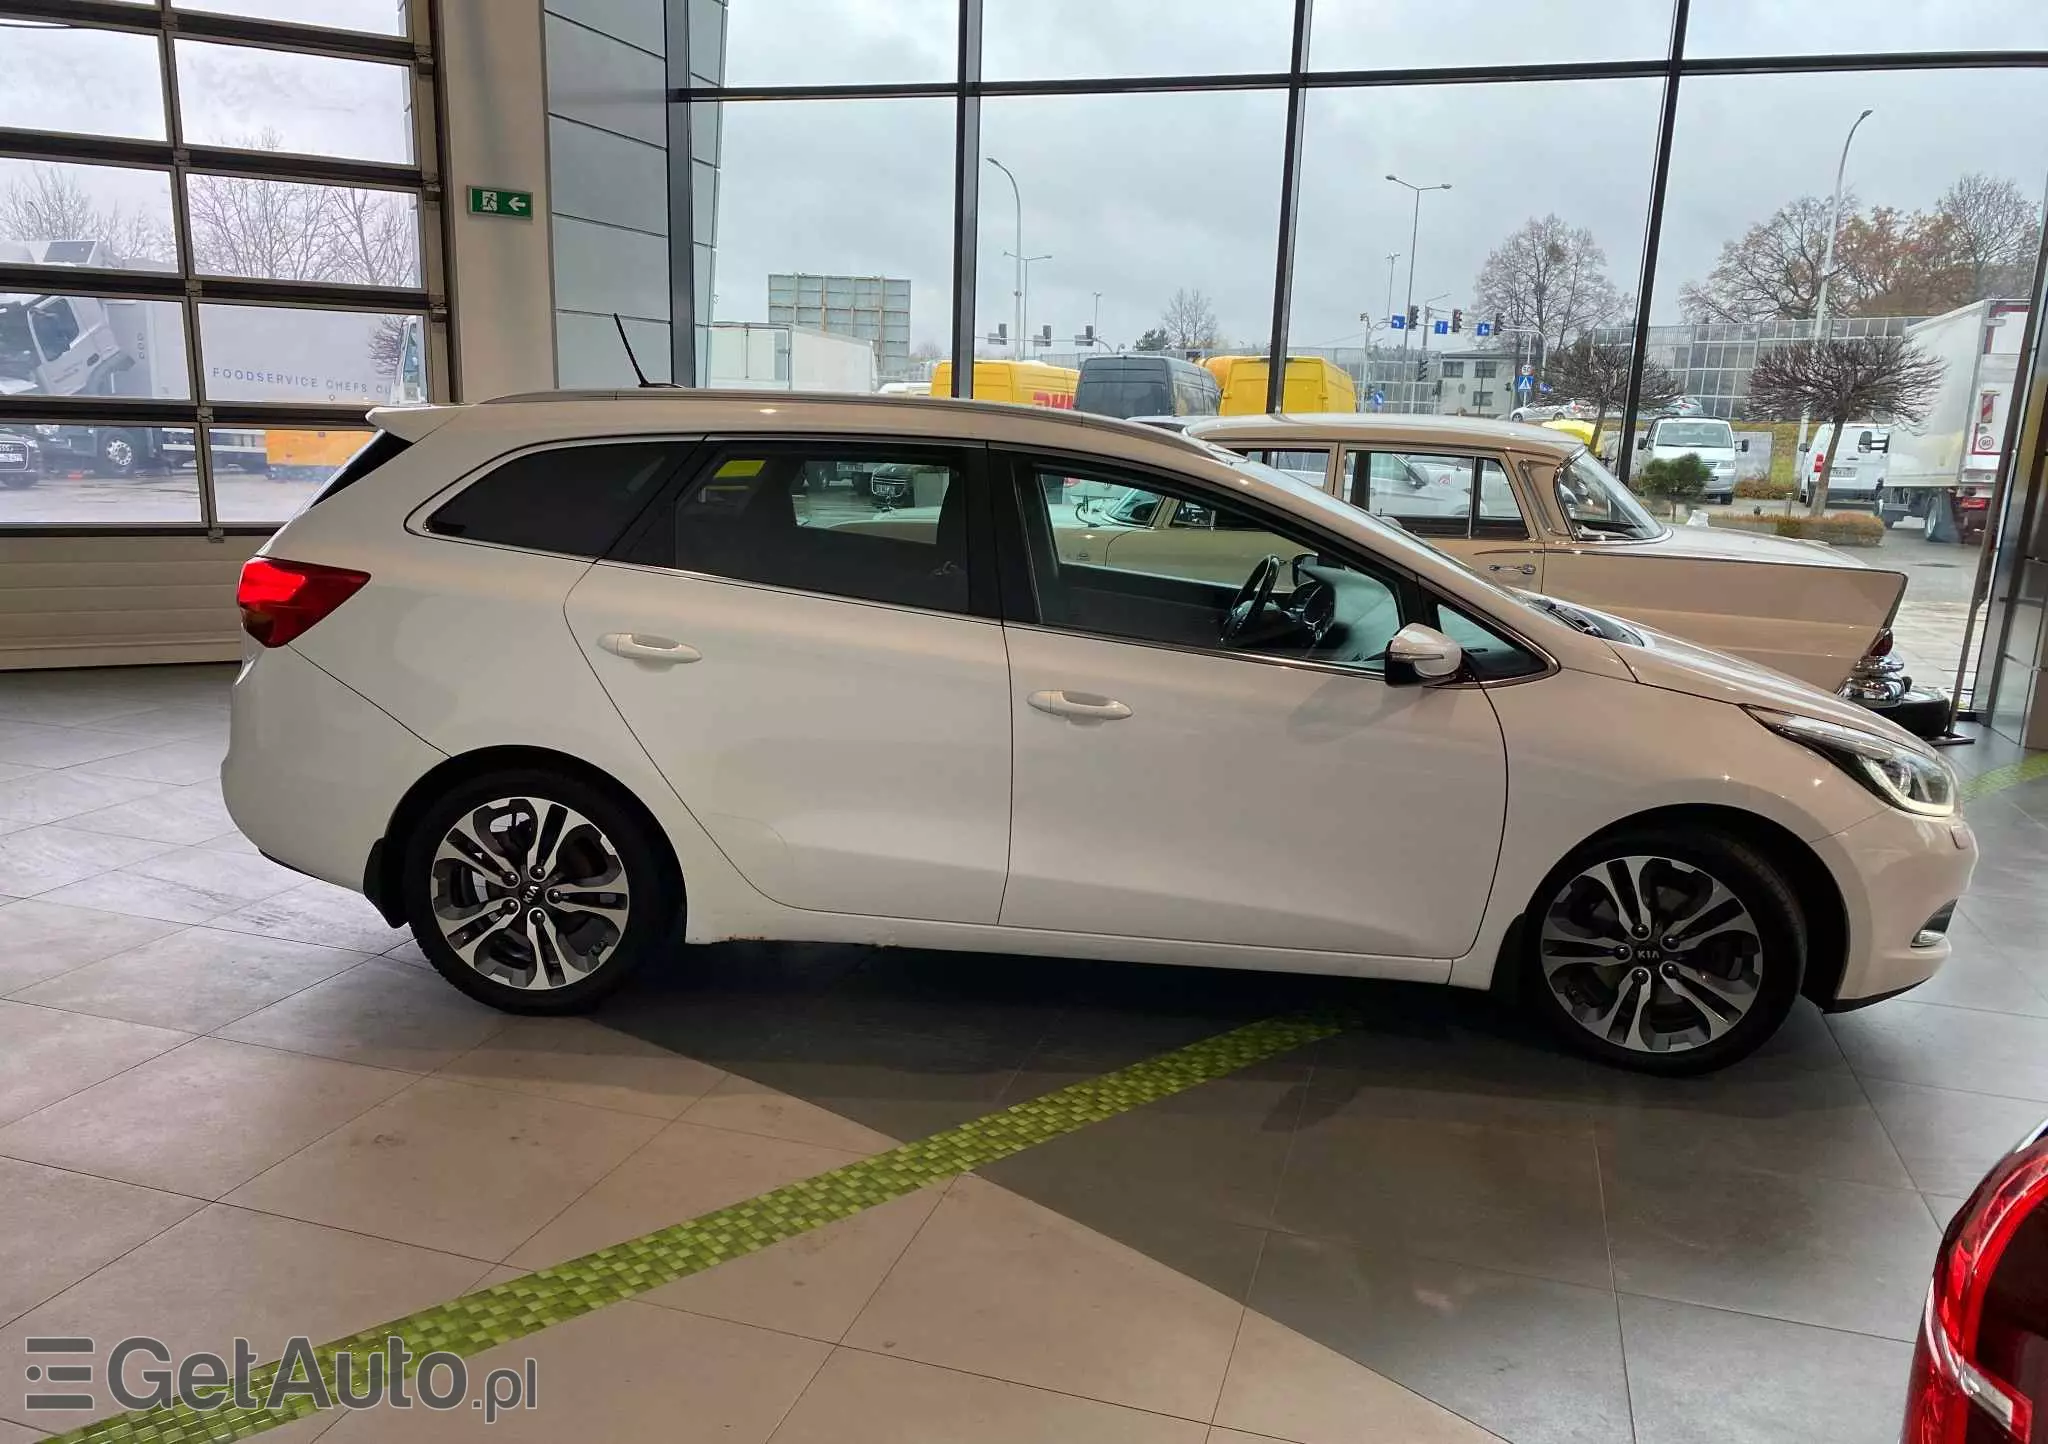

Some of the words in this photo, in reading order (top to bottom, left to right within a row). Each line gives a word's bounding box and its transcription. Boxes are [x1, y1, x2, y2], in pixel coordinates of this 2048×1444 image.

[213, 367, 318, 388] FOODSERVICE
[326, 379, 368, 393] CHEFS
[522, 885, 539, 903] KIA
[1637, 950, 1660, 959] KIA
